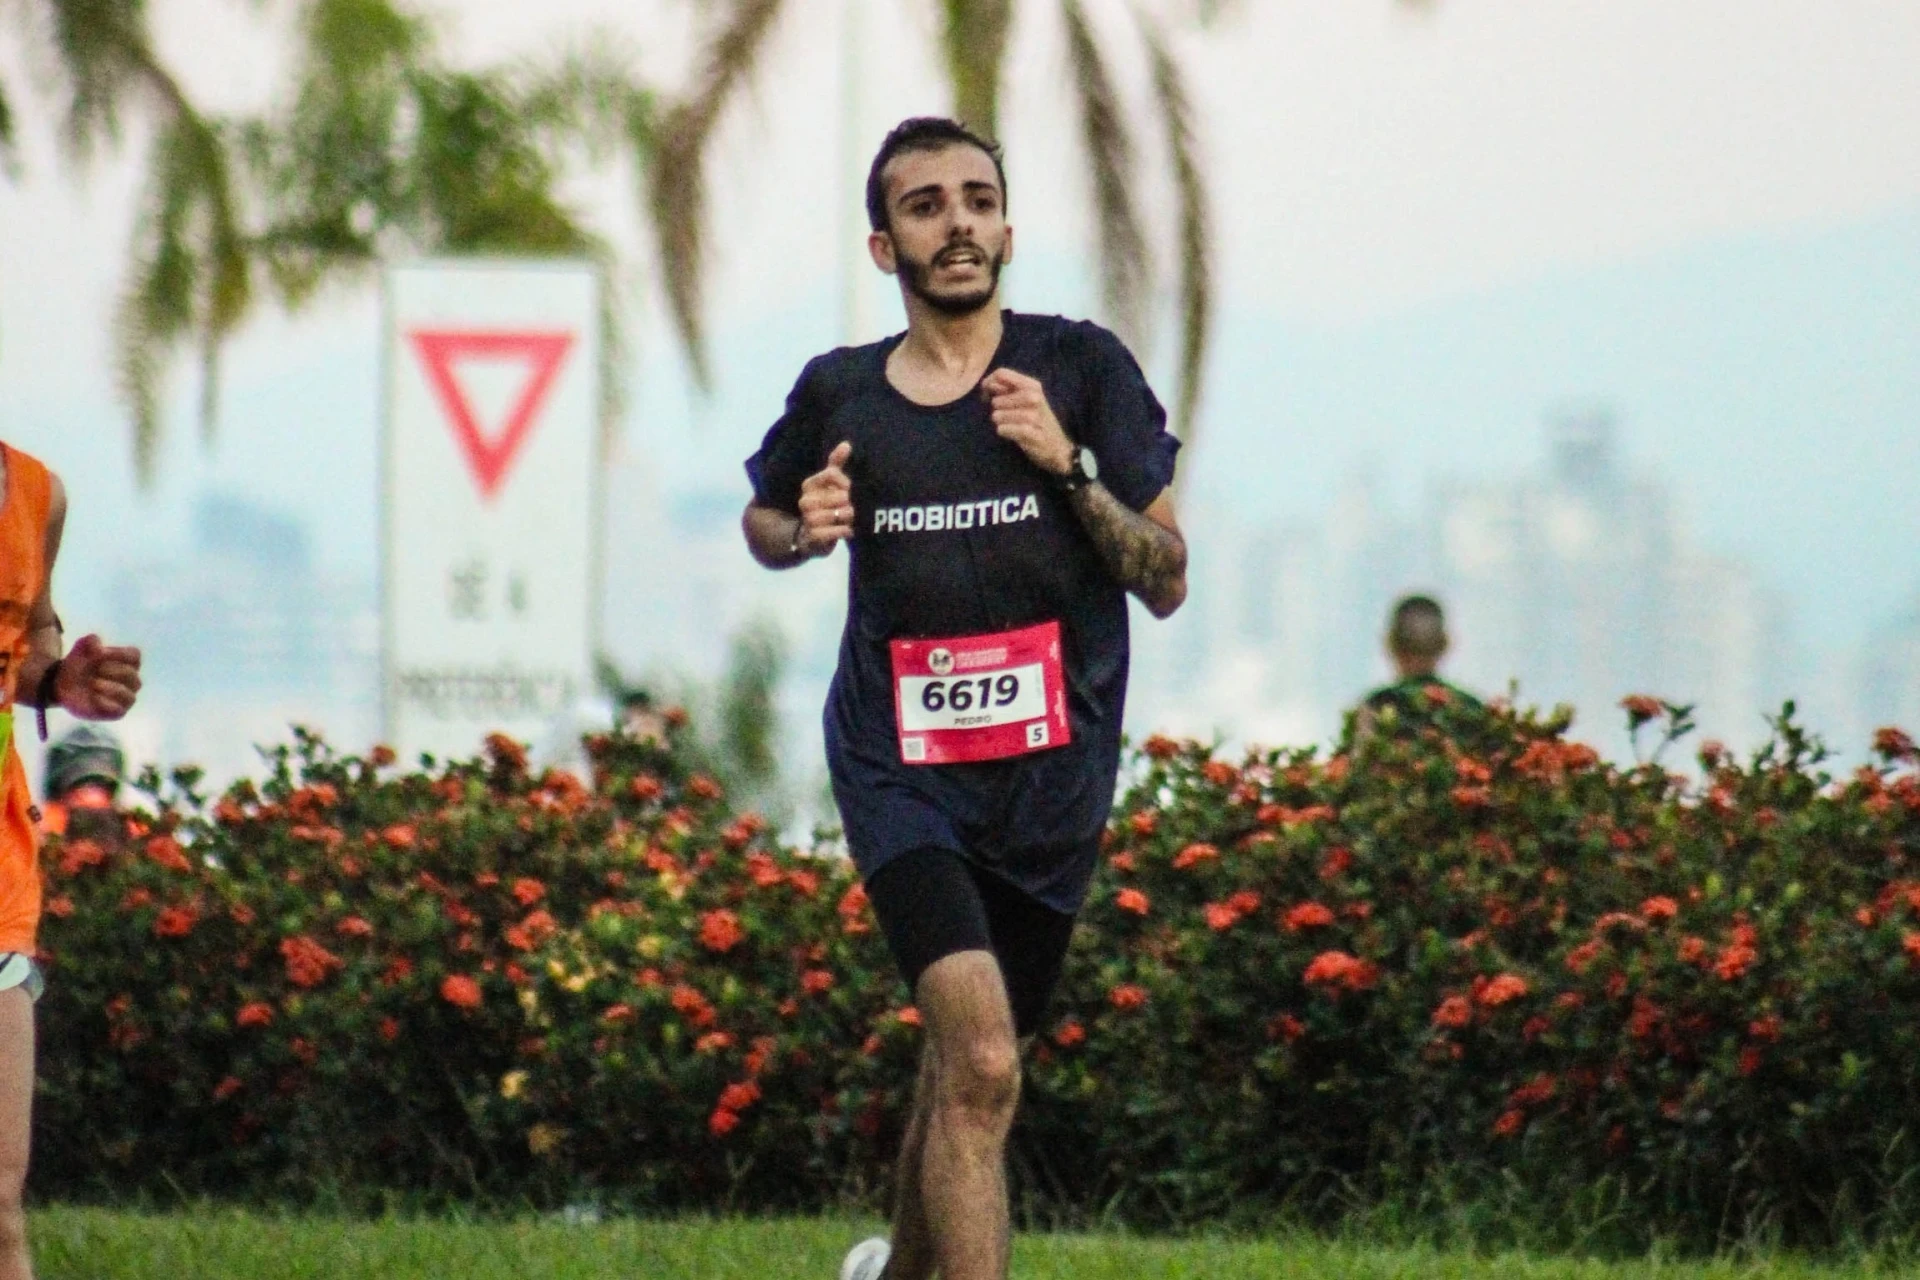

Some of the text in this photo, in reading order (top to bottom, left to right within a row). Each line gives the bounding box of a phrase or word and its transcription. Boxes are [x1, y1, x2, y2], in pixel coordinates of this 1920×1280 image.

[873, 494, 1040, 533] PROBIOTICA
[922, 674, 1019, 712] 6619
[954, 714, 992, 726] PEDRO
[1032, 727, 1043, 742] 5
